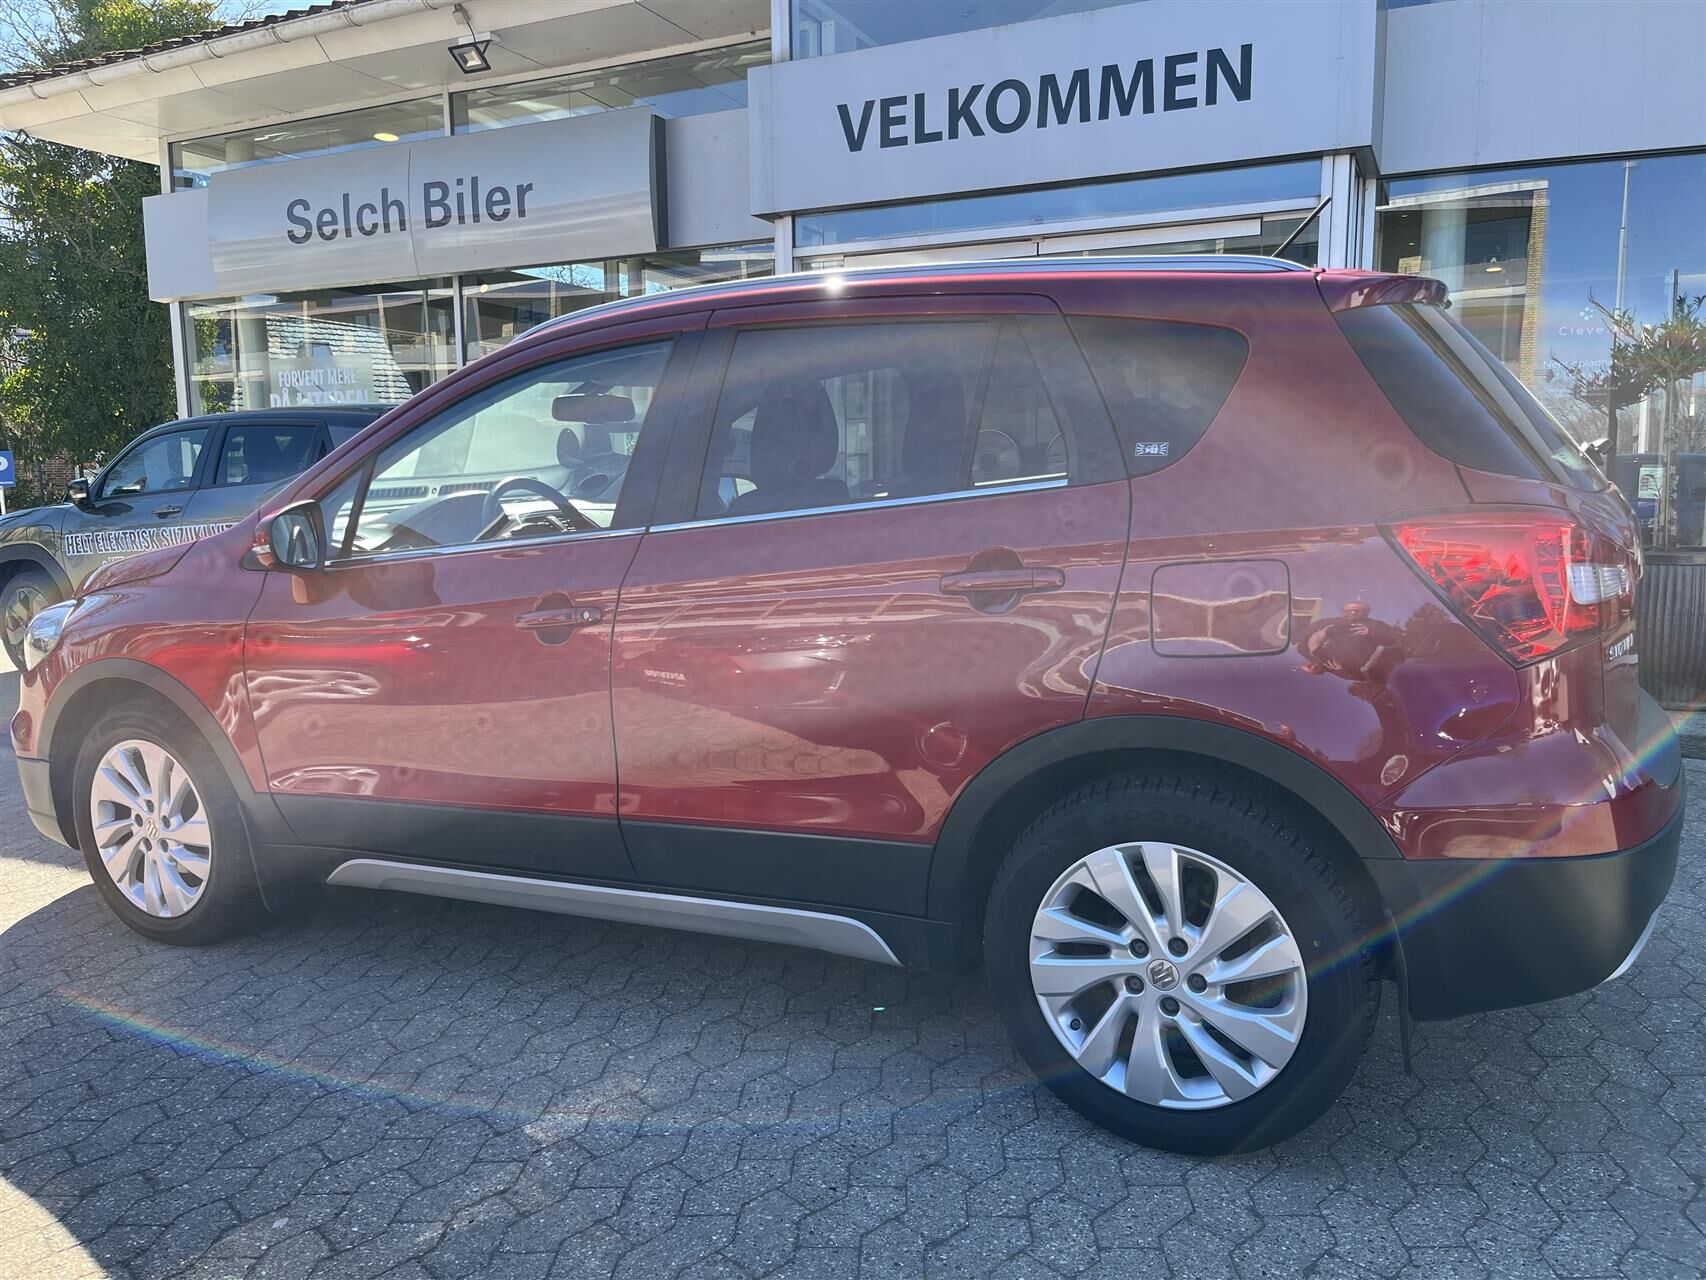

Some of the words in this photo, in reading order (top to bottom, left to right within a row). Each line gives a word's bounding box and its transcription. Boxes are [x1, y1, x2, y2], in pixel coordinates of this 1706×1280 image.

[836, 43, 1253, 153] VELKOMMEN
[286, 187, 407, 245] Selch
[423, 175, 533, 229] Biler
[278, 369, 324, 387] FORVENT
[327, 367, 357, 385] MERE
[65, 533, 93, 556] HELT
[94, 528, 160, 553] ELEKTRISK
[1102, 808, 1273, 866] GOODRIDE
